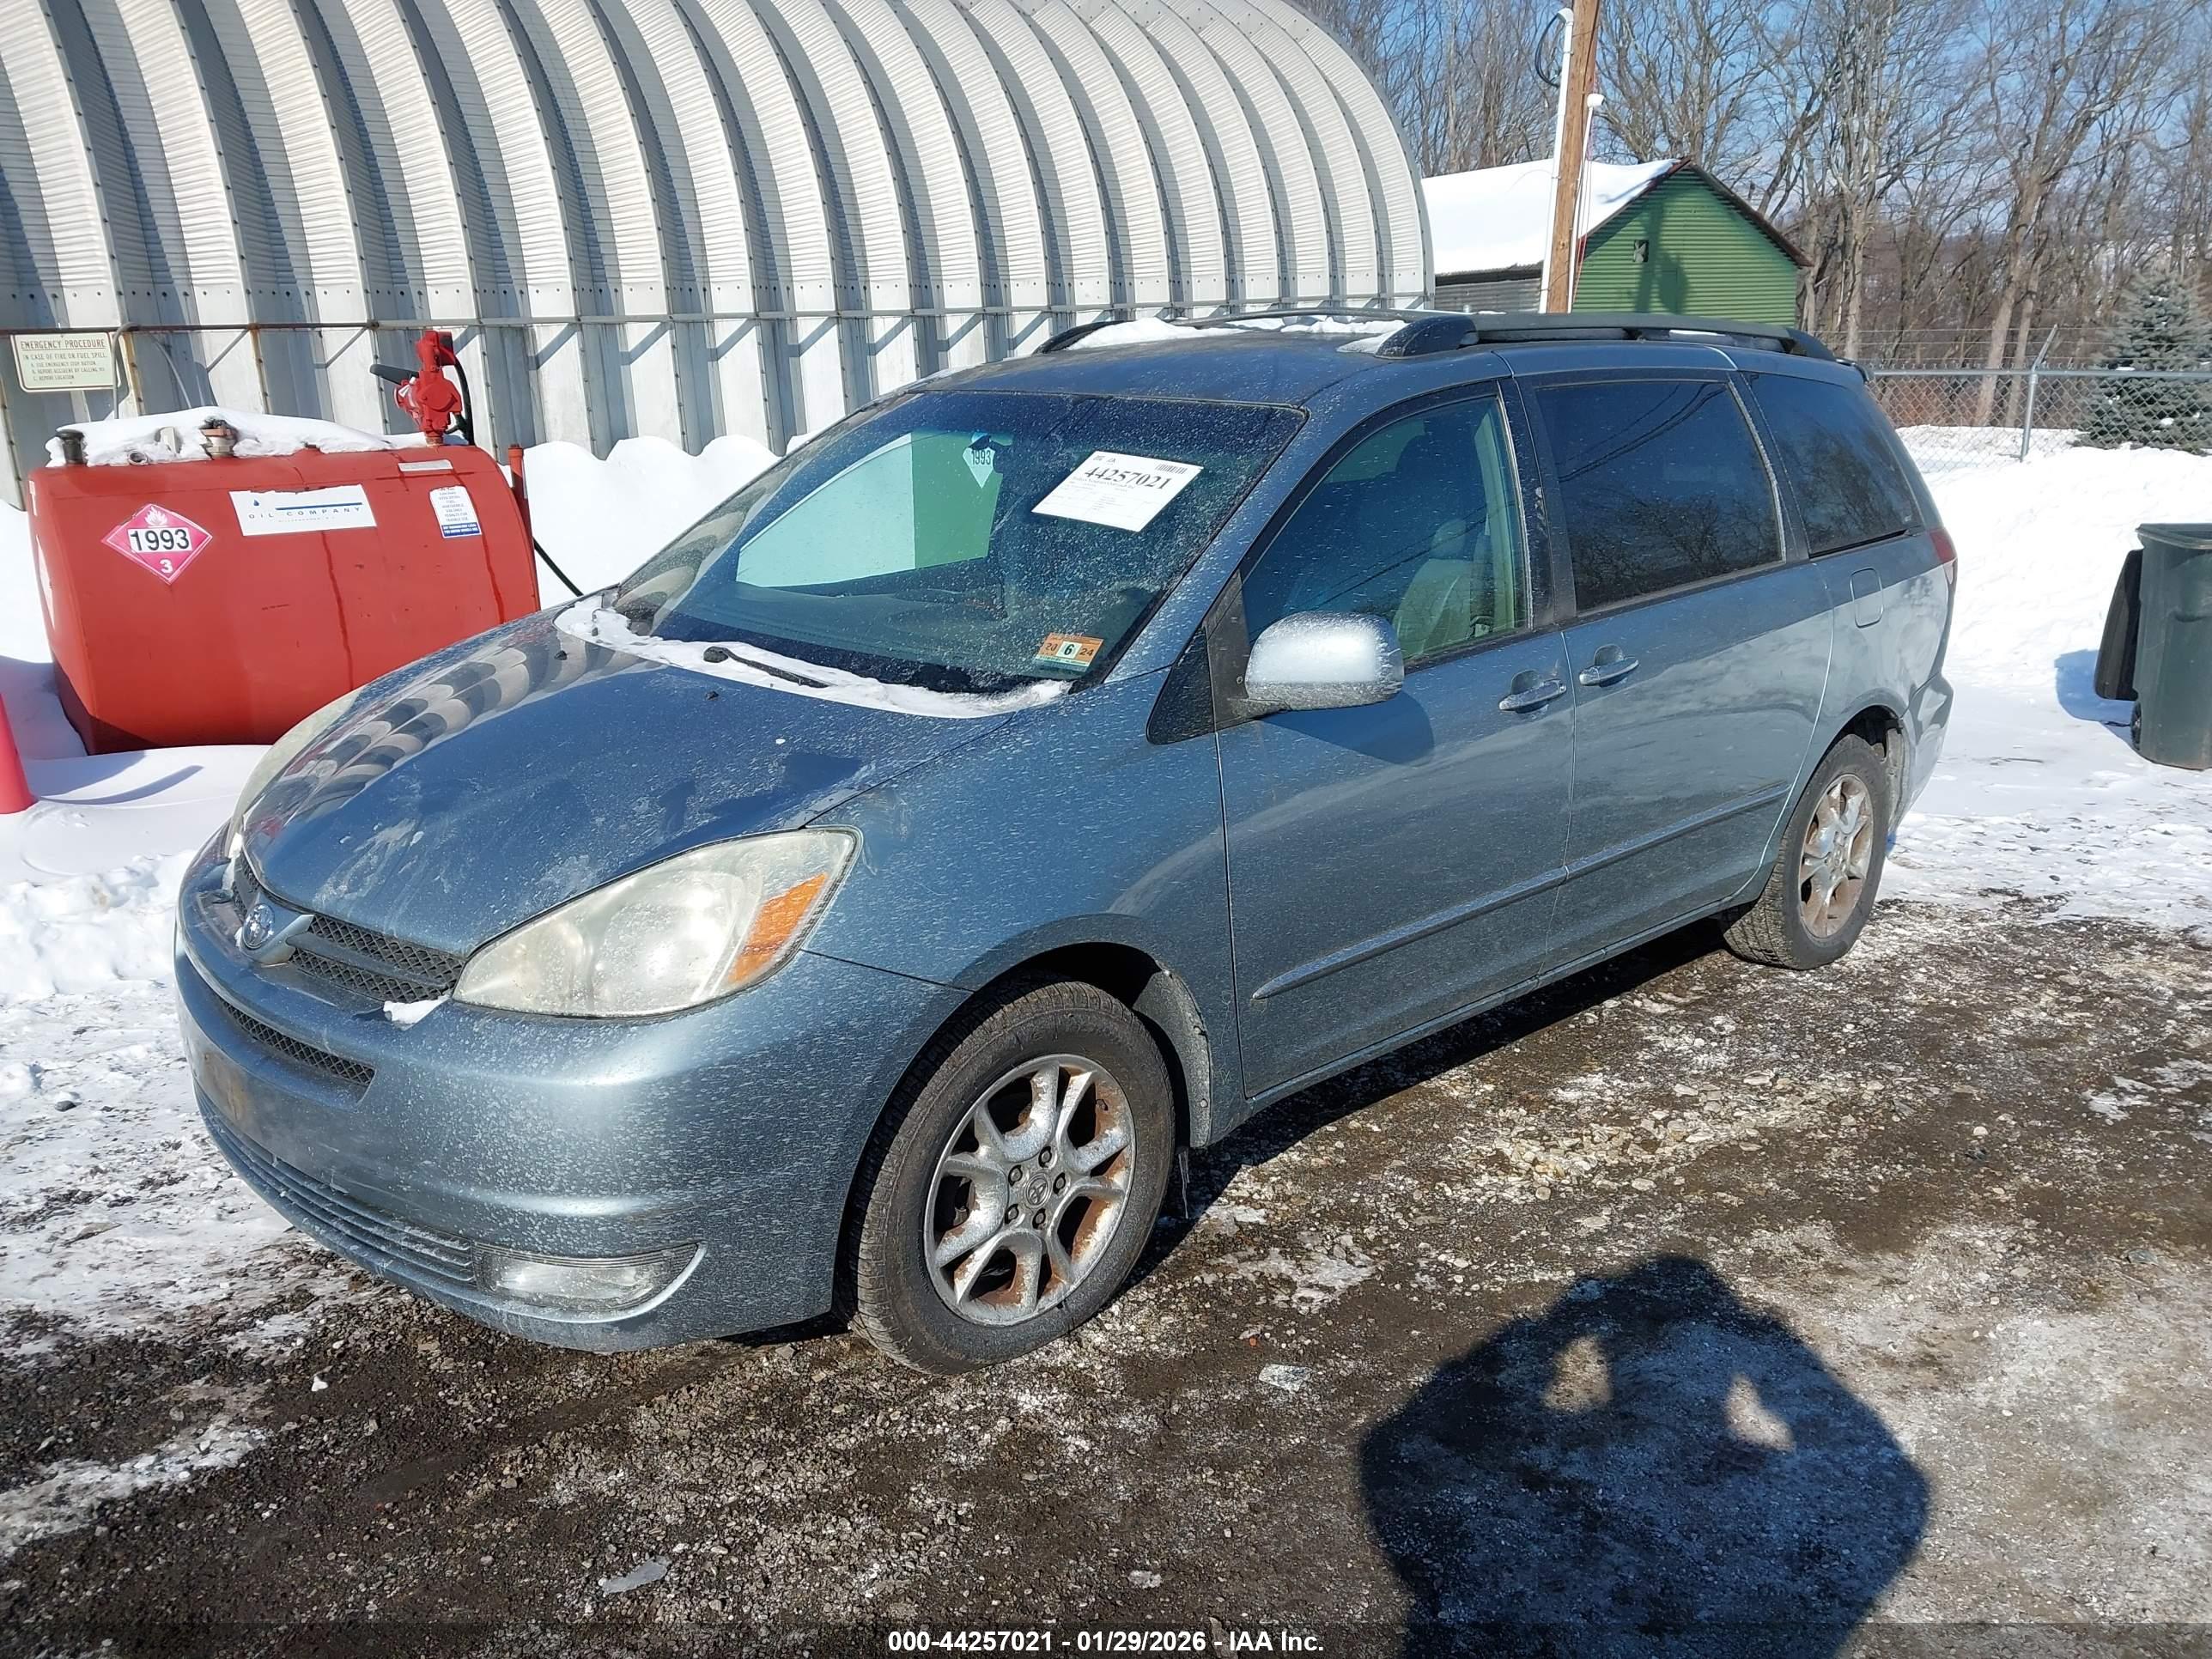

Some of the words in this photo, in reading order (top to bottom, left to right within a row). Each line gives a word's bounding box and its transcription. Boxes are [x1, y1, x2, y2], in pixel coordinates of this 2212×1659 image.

[21, 340, 61, 349] EMERGENCY
[64, 338, 106, 348] PROCEDURE
[1085, 466, 1173, 489] 44257021
[286, 507, 361, 517] COMPANY
[130, 528, 190, 551] 1993
[160, 558, 173, 574] 3
[1045, 642, 1059, 652] 20
[1064, 643, 1075, 655] 6
[1079, 647, 1095, 657] 24
